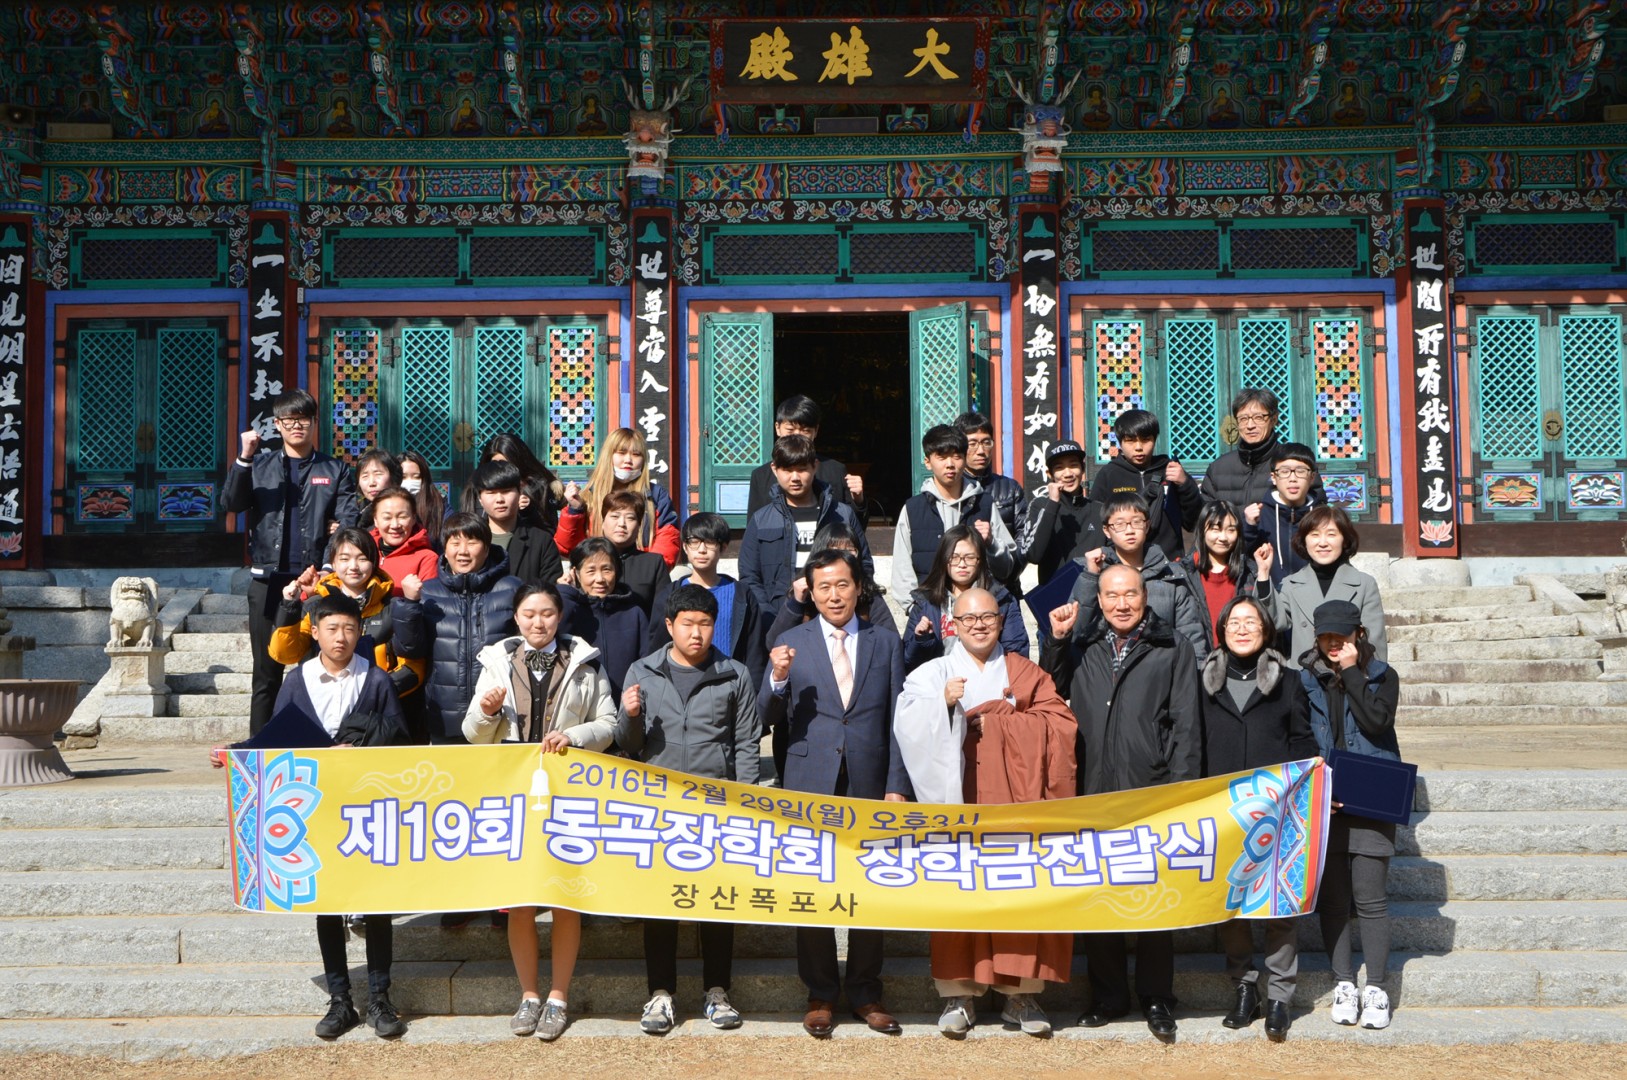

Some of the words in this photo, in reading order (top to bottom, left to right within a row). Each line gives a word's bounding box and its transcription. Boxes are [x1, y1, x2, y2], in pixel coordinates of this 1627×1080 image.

[566, 761, 668, 799] 2016년
[681, 780, 727, 806] 2월
[739, 792, 857, 830] 29일(월)
[868, 810, 981, 831] 오후3시
[337, 793, 526, 867] 제19회
[543, 795, 837, 883] 동곡장학회
[857, 816, 1218, 892] 장학금전달식
